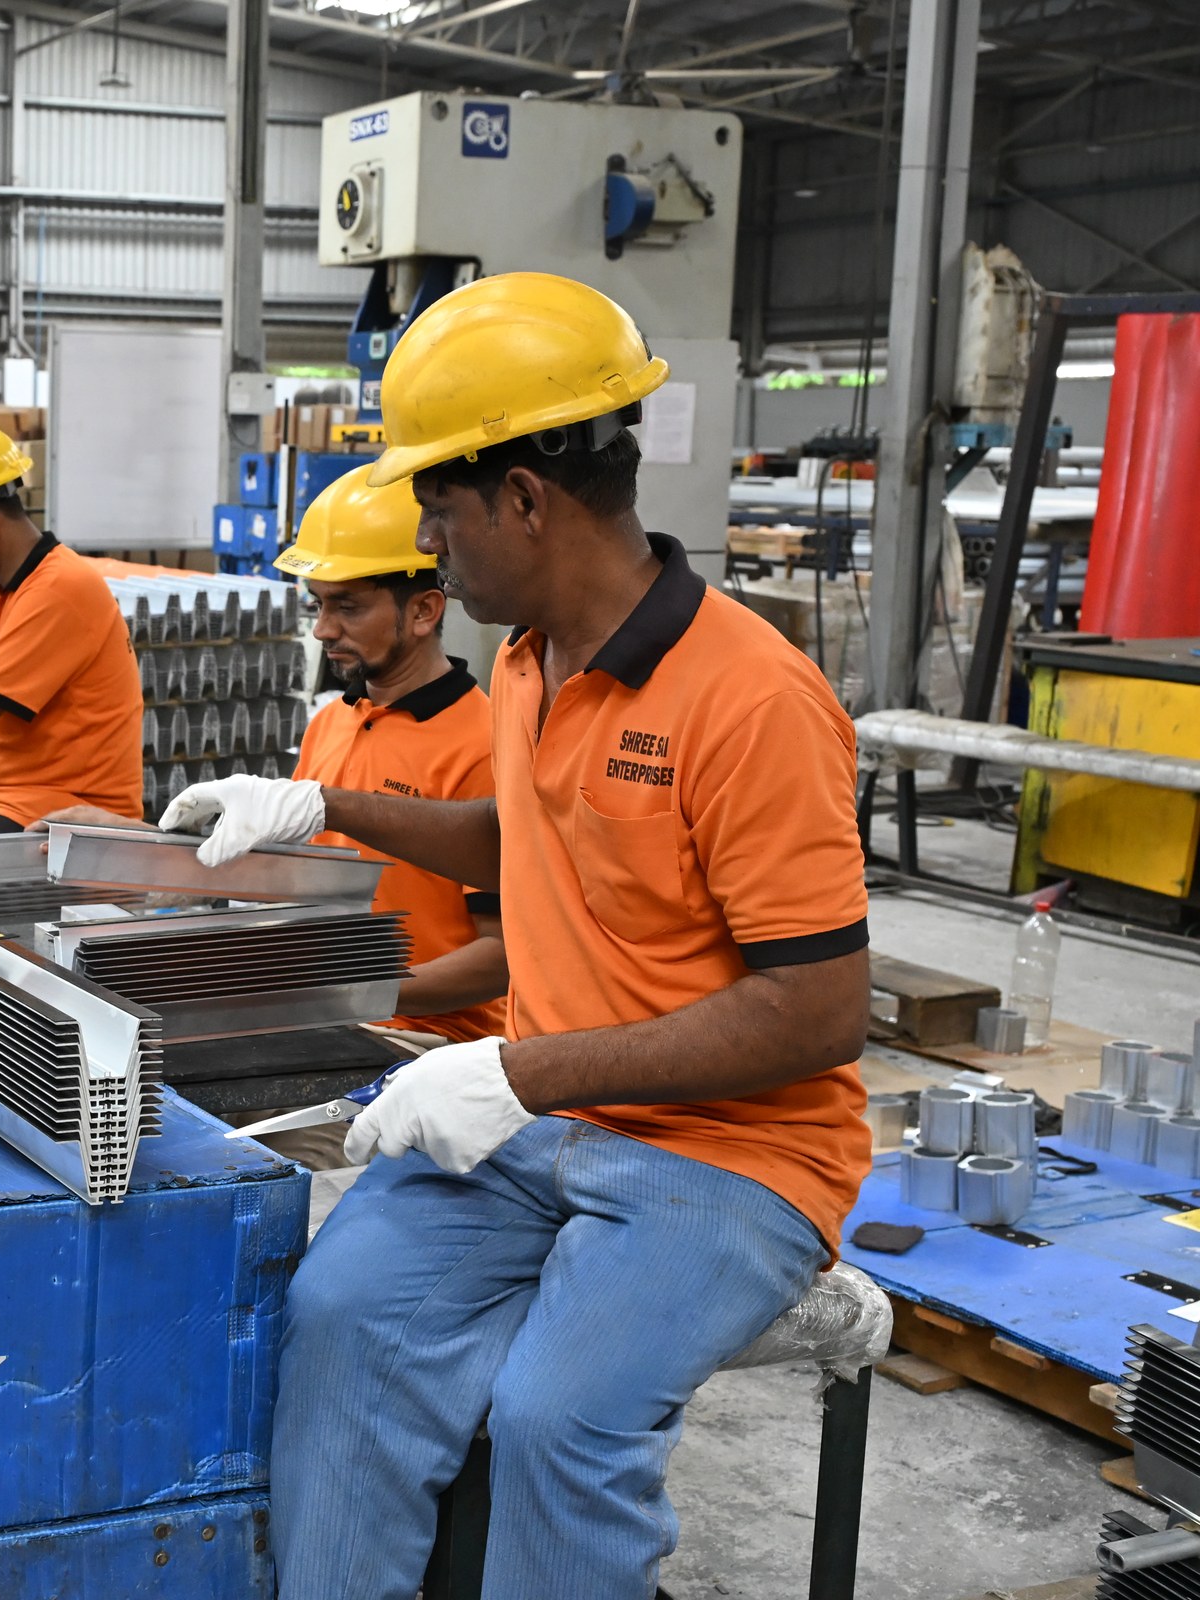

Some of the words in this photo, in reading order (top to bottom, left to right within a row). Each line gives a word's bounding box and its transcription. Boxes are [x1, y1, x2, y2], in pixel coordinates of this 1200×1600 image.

[619, 729, 657, 756] SHREE
[606, 757, 675, 787] ENTERPRISES
[383, 778, 412, 795] SHREE
